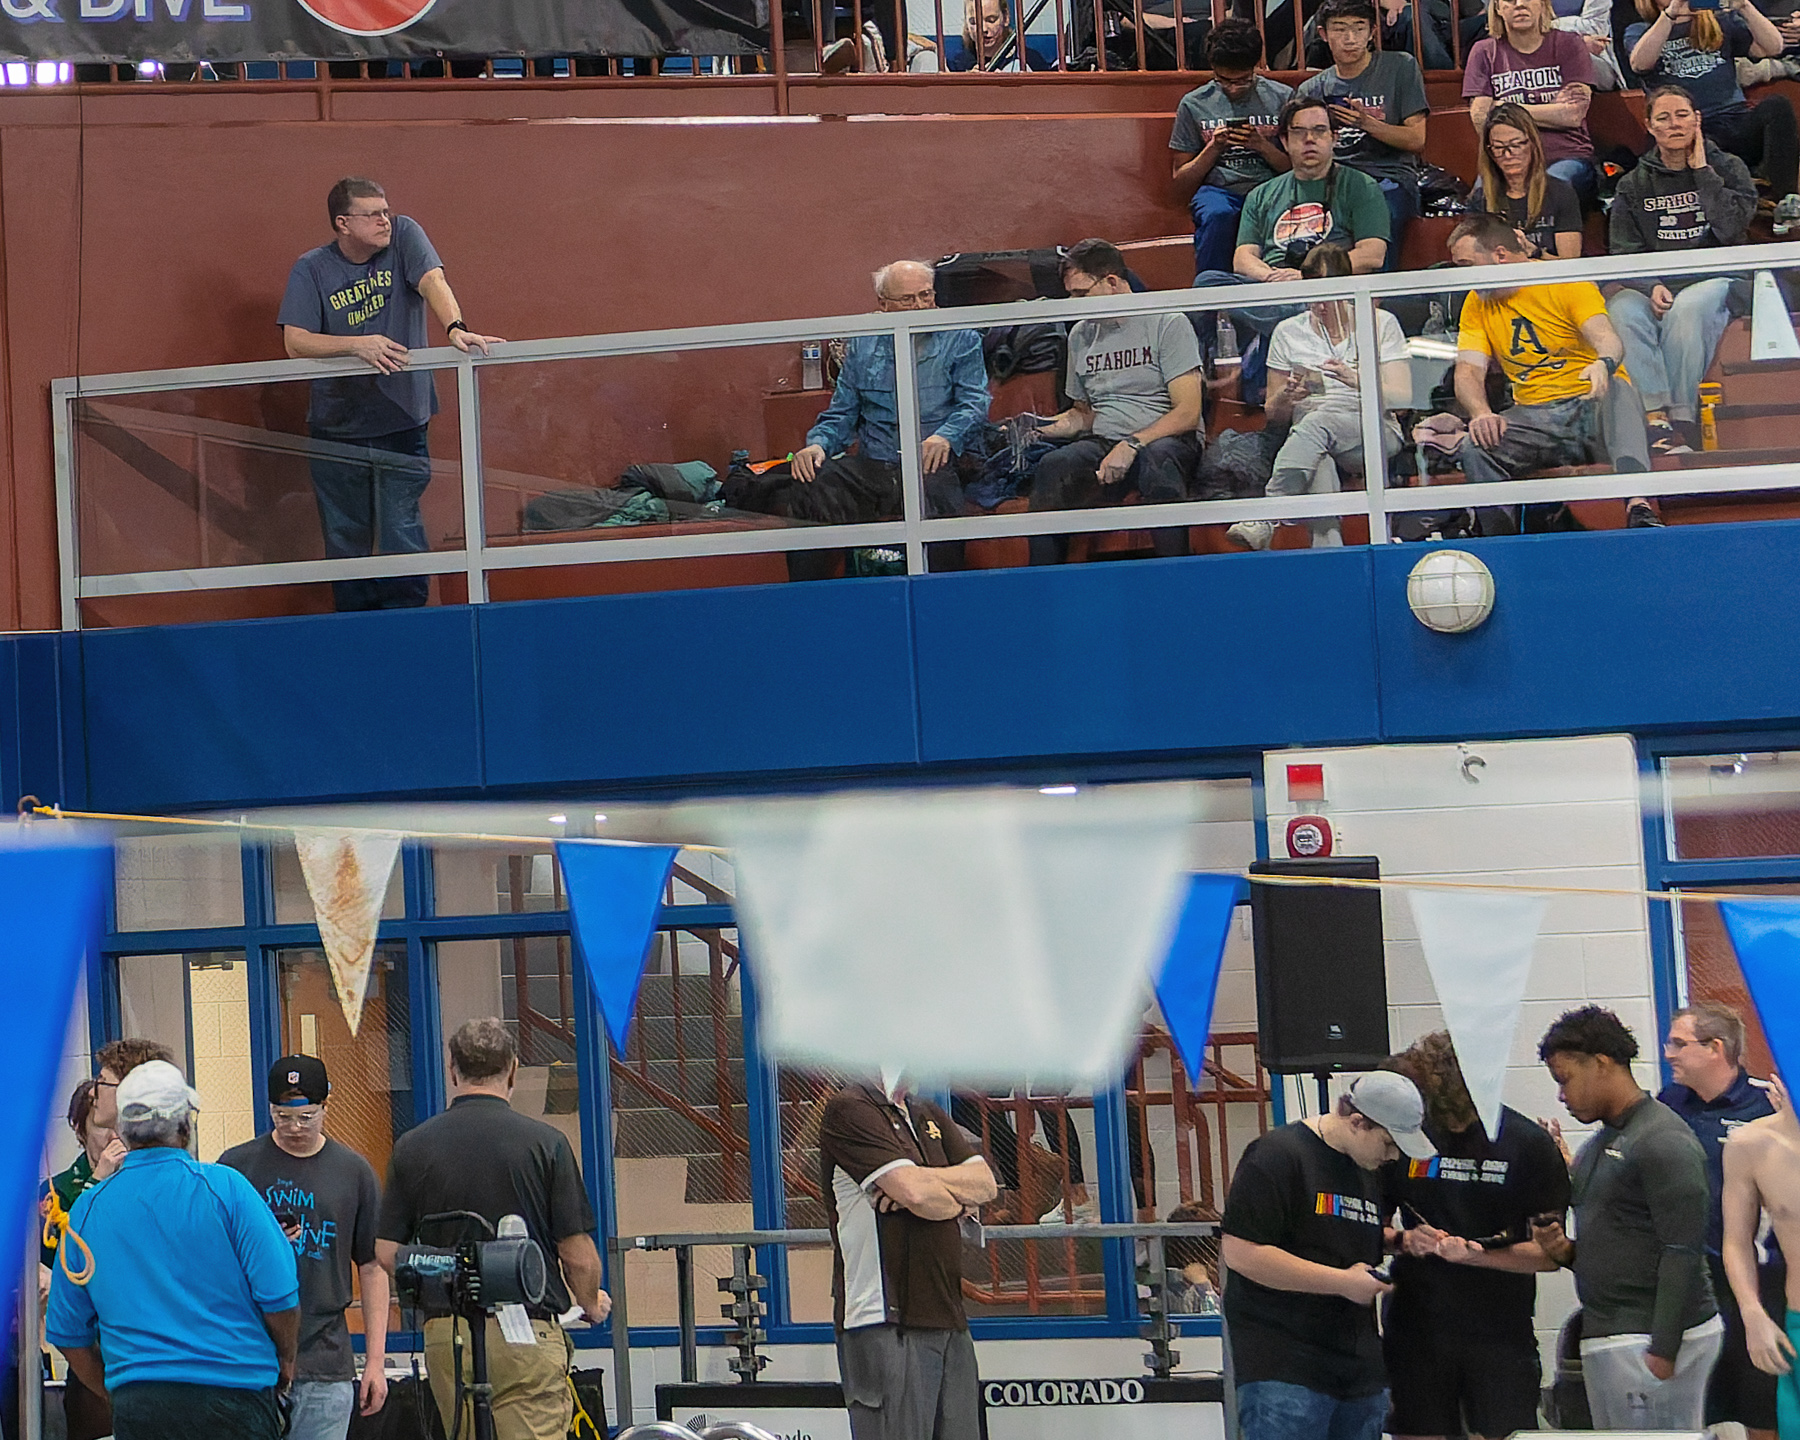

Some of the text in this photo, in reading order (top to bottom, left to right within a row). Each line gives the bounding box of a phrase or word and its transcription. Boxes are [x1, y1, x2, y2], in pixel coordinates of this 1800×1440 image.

[1644, 192, 1700, 211] SEAHO
[1510, 317, 1548, 356] A
[1086, 345, 1153, 373] SEAHOLM
[984, 1378, 1145, 1406] COLORADO
